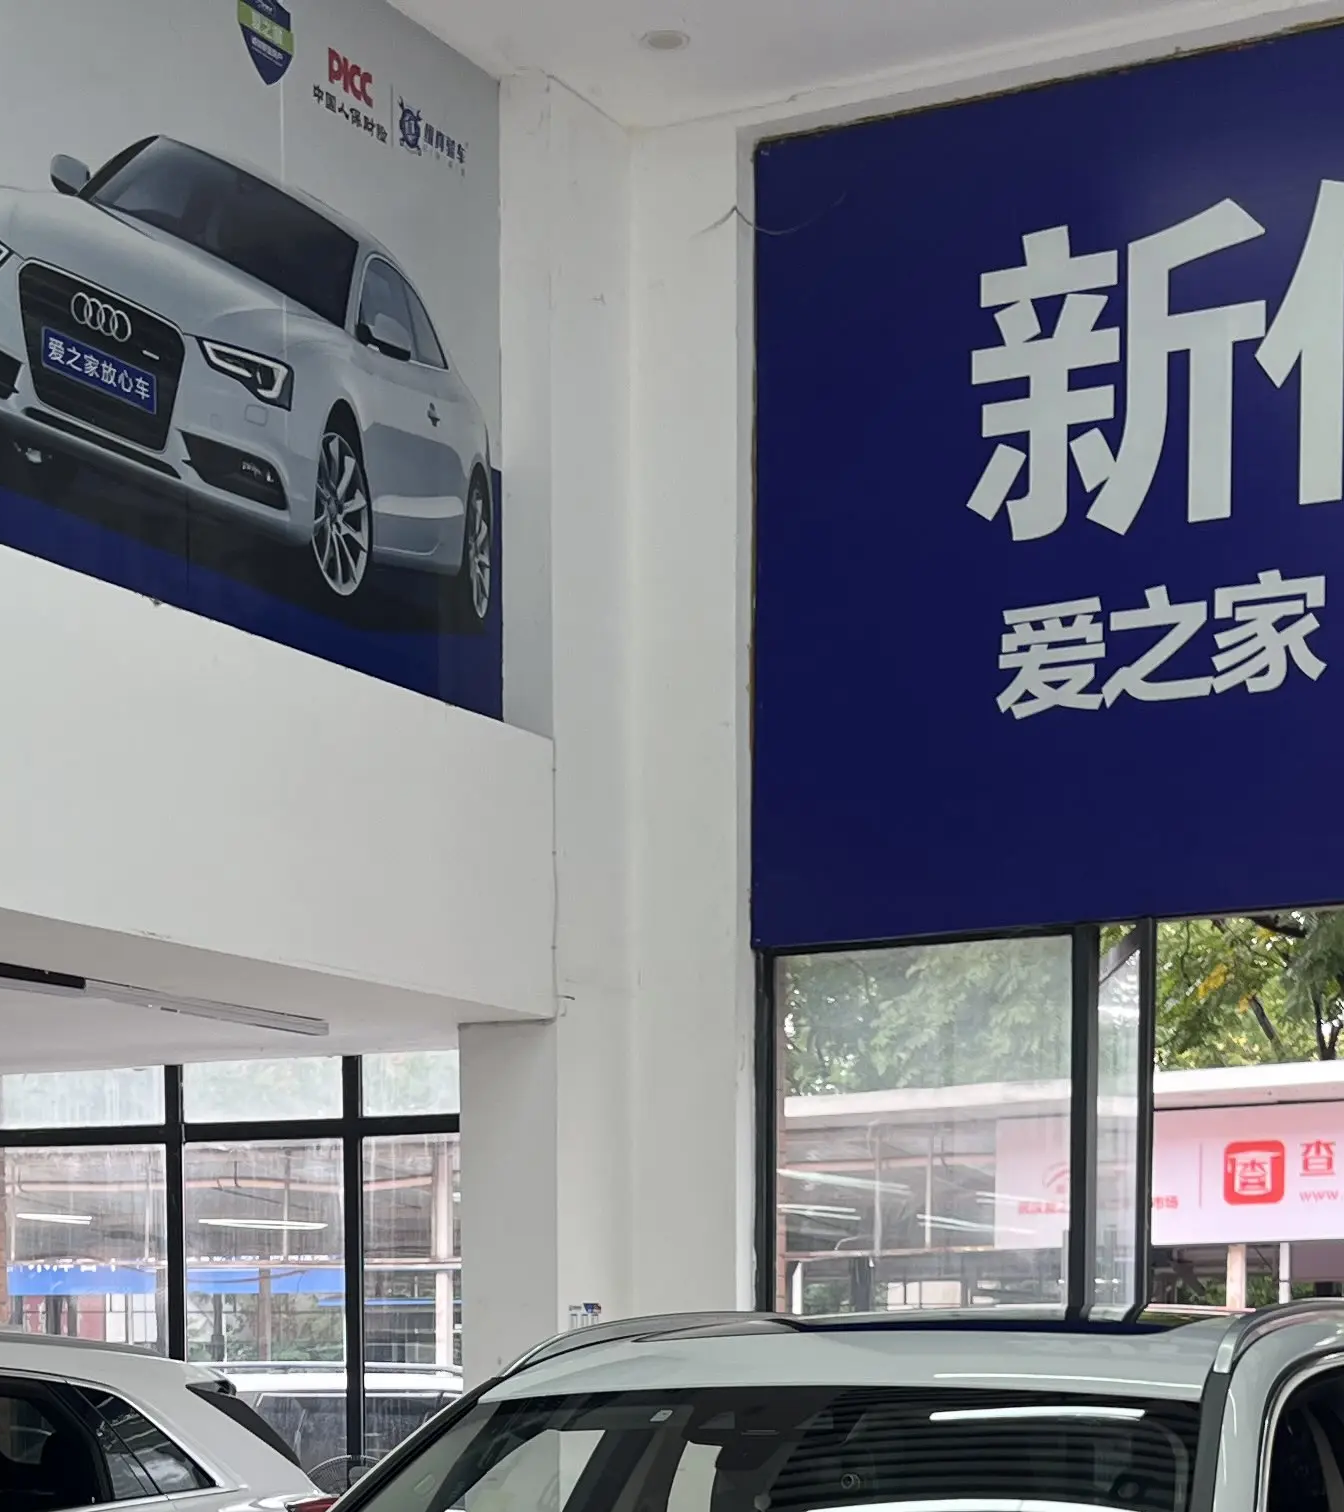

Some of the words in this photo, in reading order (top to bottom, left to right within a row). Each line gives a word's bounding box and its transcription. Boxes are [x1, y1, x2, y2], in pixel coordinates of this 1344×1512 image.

[327, 46, 374, 109] PICC
[48, 336, 151, 400] 爱之家放心车
[995, 570, 1327, 720] 爱之家
